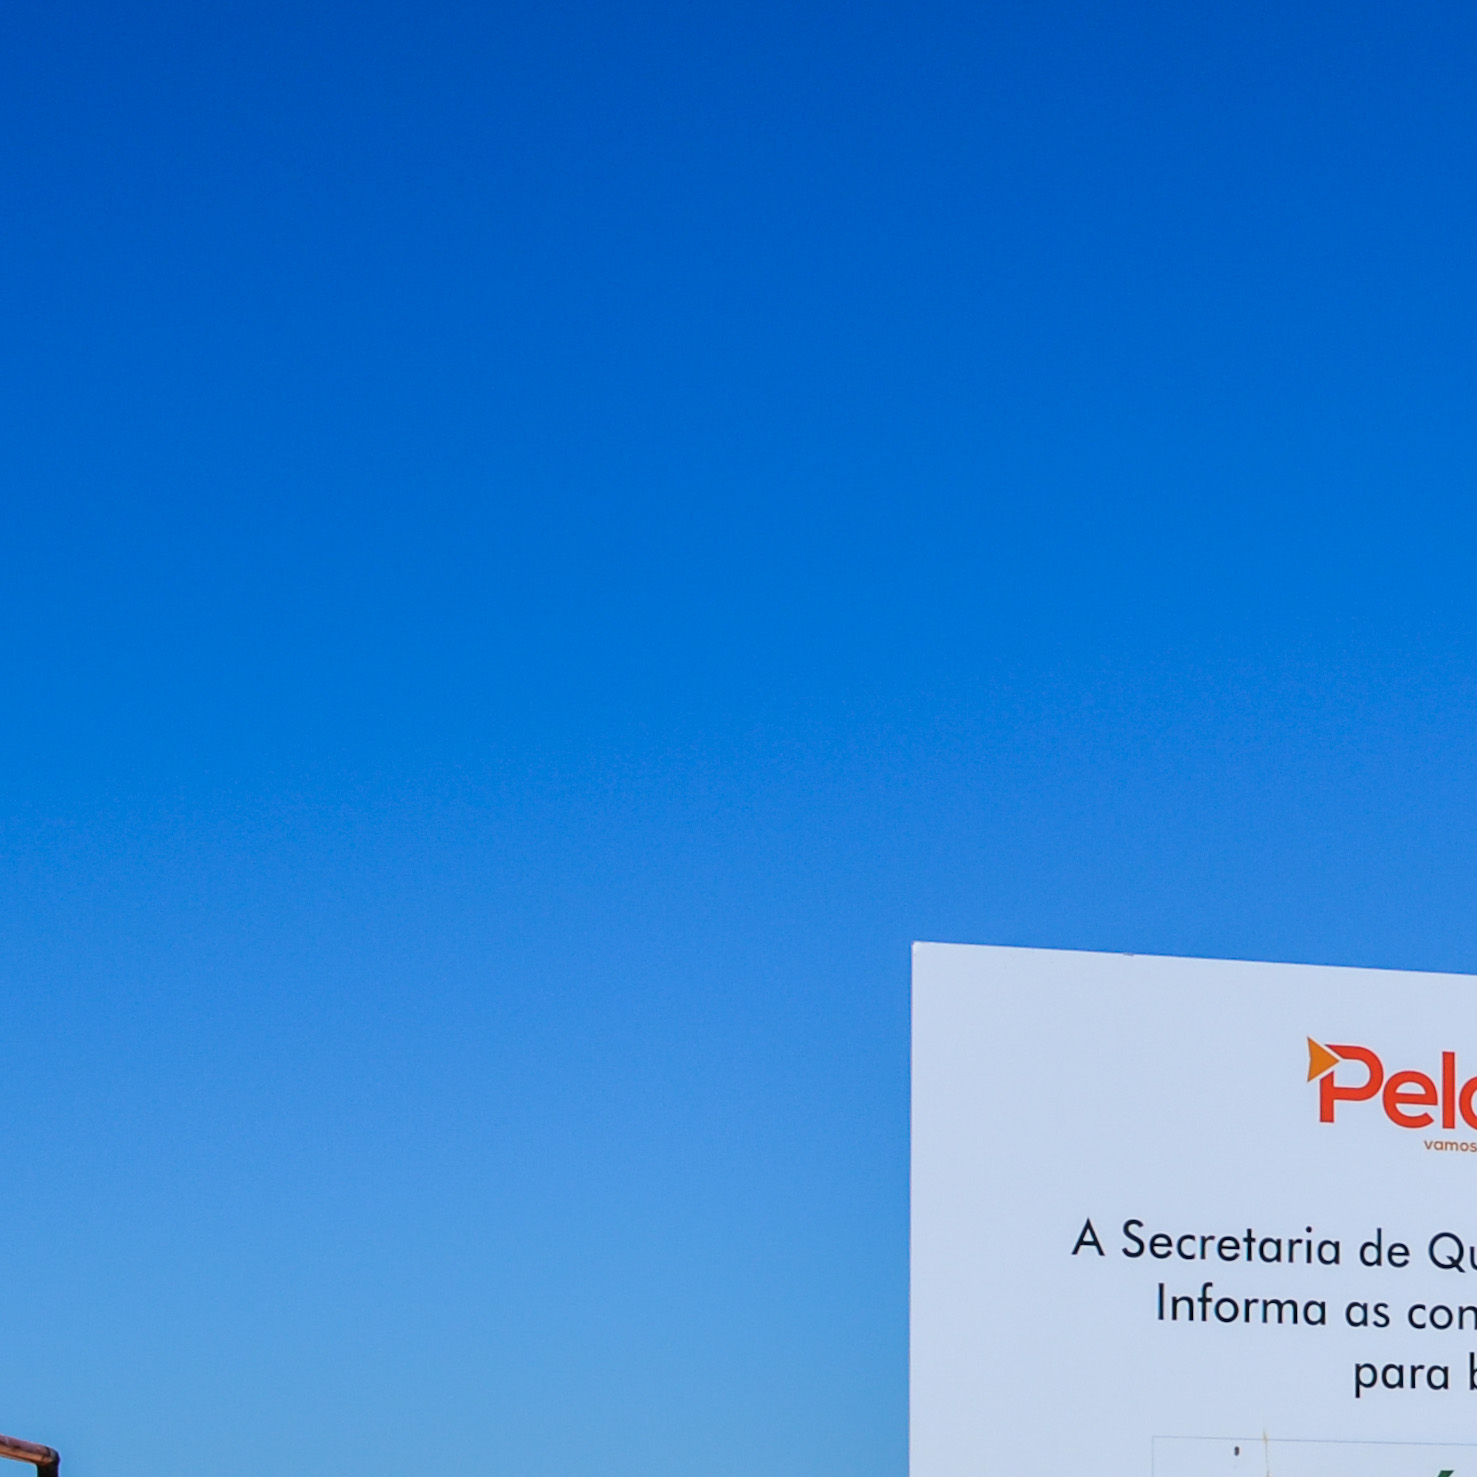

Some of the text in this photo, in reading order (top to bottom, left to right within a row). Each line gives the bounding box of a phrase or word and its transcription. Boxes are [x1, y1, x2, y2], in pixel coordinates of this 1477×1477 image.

[1423, 1140, 1477, 1153] vamos
[1071, 1217, 1105, 1257] A
[1121, 1219, 1340, 1266] Secretaria
[1358, 1227, 1410, 1269] de
[1156, 1282, 1327, 1327] Informa
[1344, 1302, 1391, 1329] as
[1354, 1362, 1450, 1399] para
